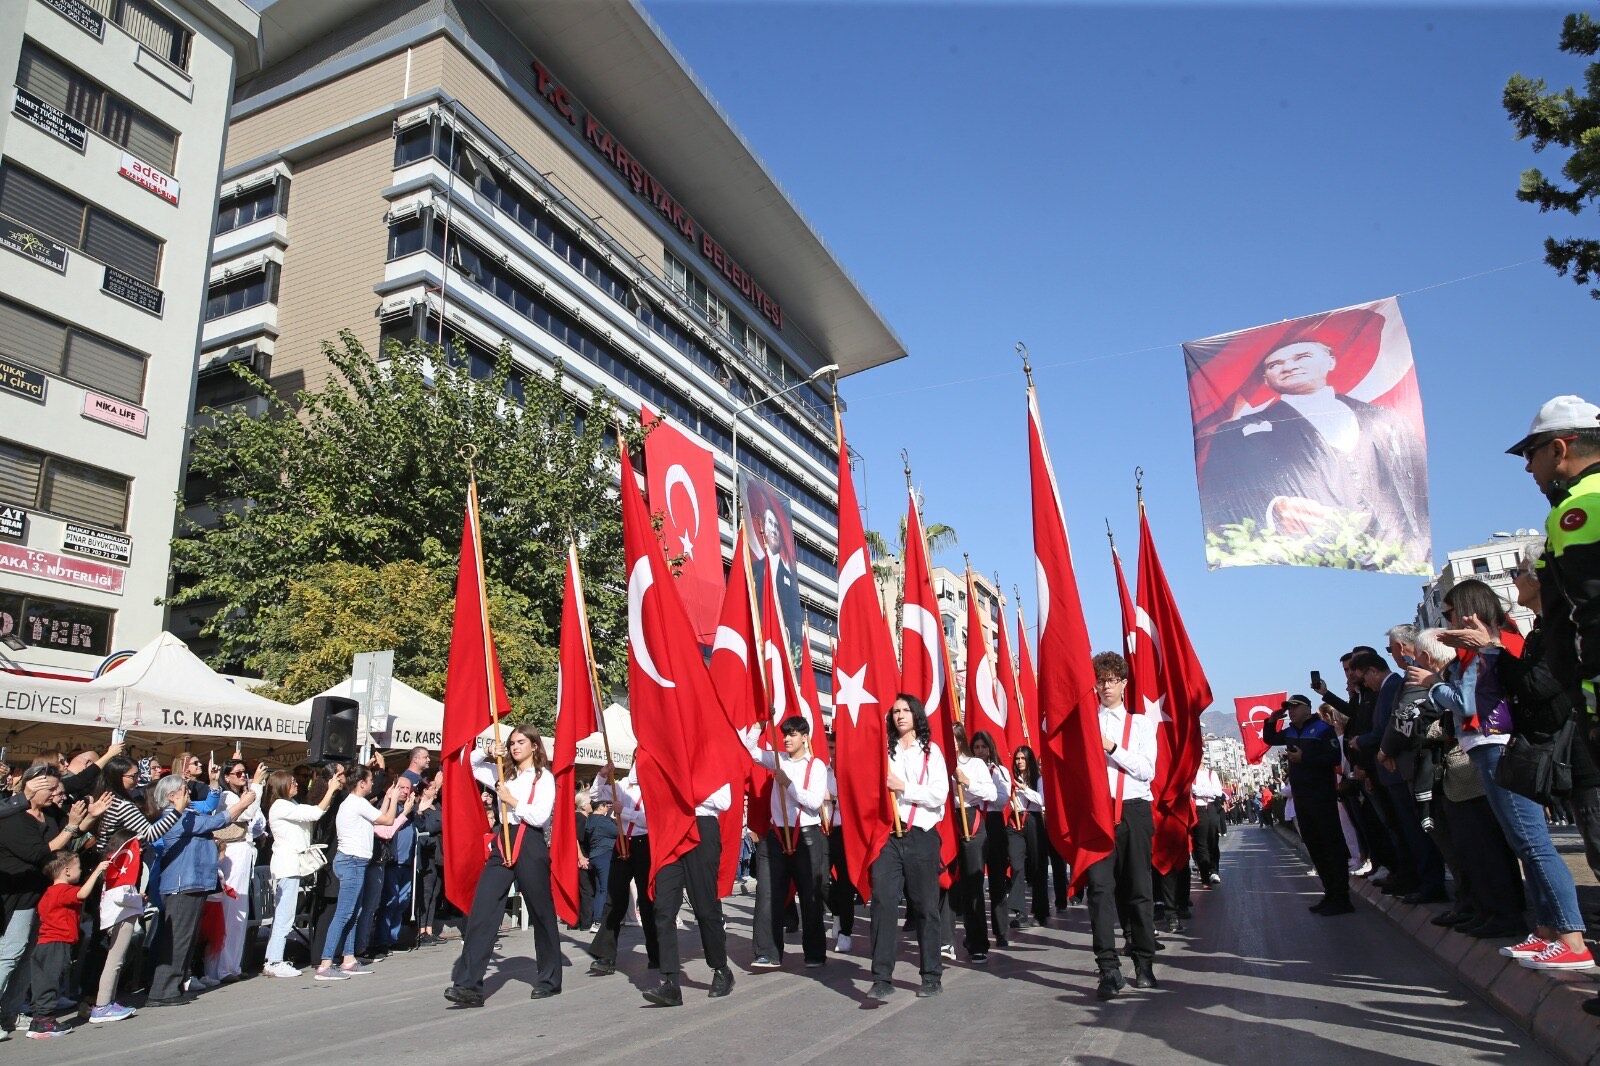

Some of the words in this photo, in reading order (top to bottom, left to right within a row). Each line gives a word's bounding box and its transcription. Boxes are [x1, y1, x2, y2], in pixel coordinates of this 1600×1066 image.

[17, 94, 39, 112] AHMET
[42, 102, 64, 118] AVUKAT
[532, 60, 576, 125] T.C.
[583, 111, 695, 244] KARŞIYAKA
[132, 161, 168, 187] aden
[0, 363, 26, 378] UKAT
[27, 550, 47, 563] T.C.
[32, 562, 42, 573] 3.
[162, 708, 188, 726] T.C.
[193, 711, 273, 731] KARŞIYAKA
[276, 718, 310, 735] BELED
[396, 730, 412, 744] T.C.
[415, 731, 442, 746] KARŞ
